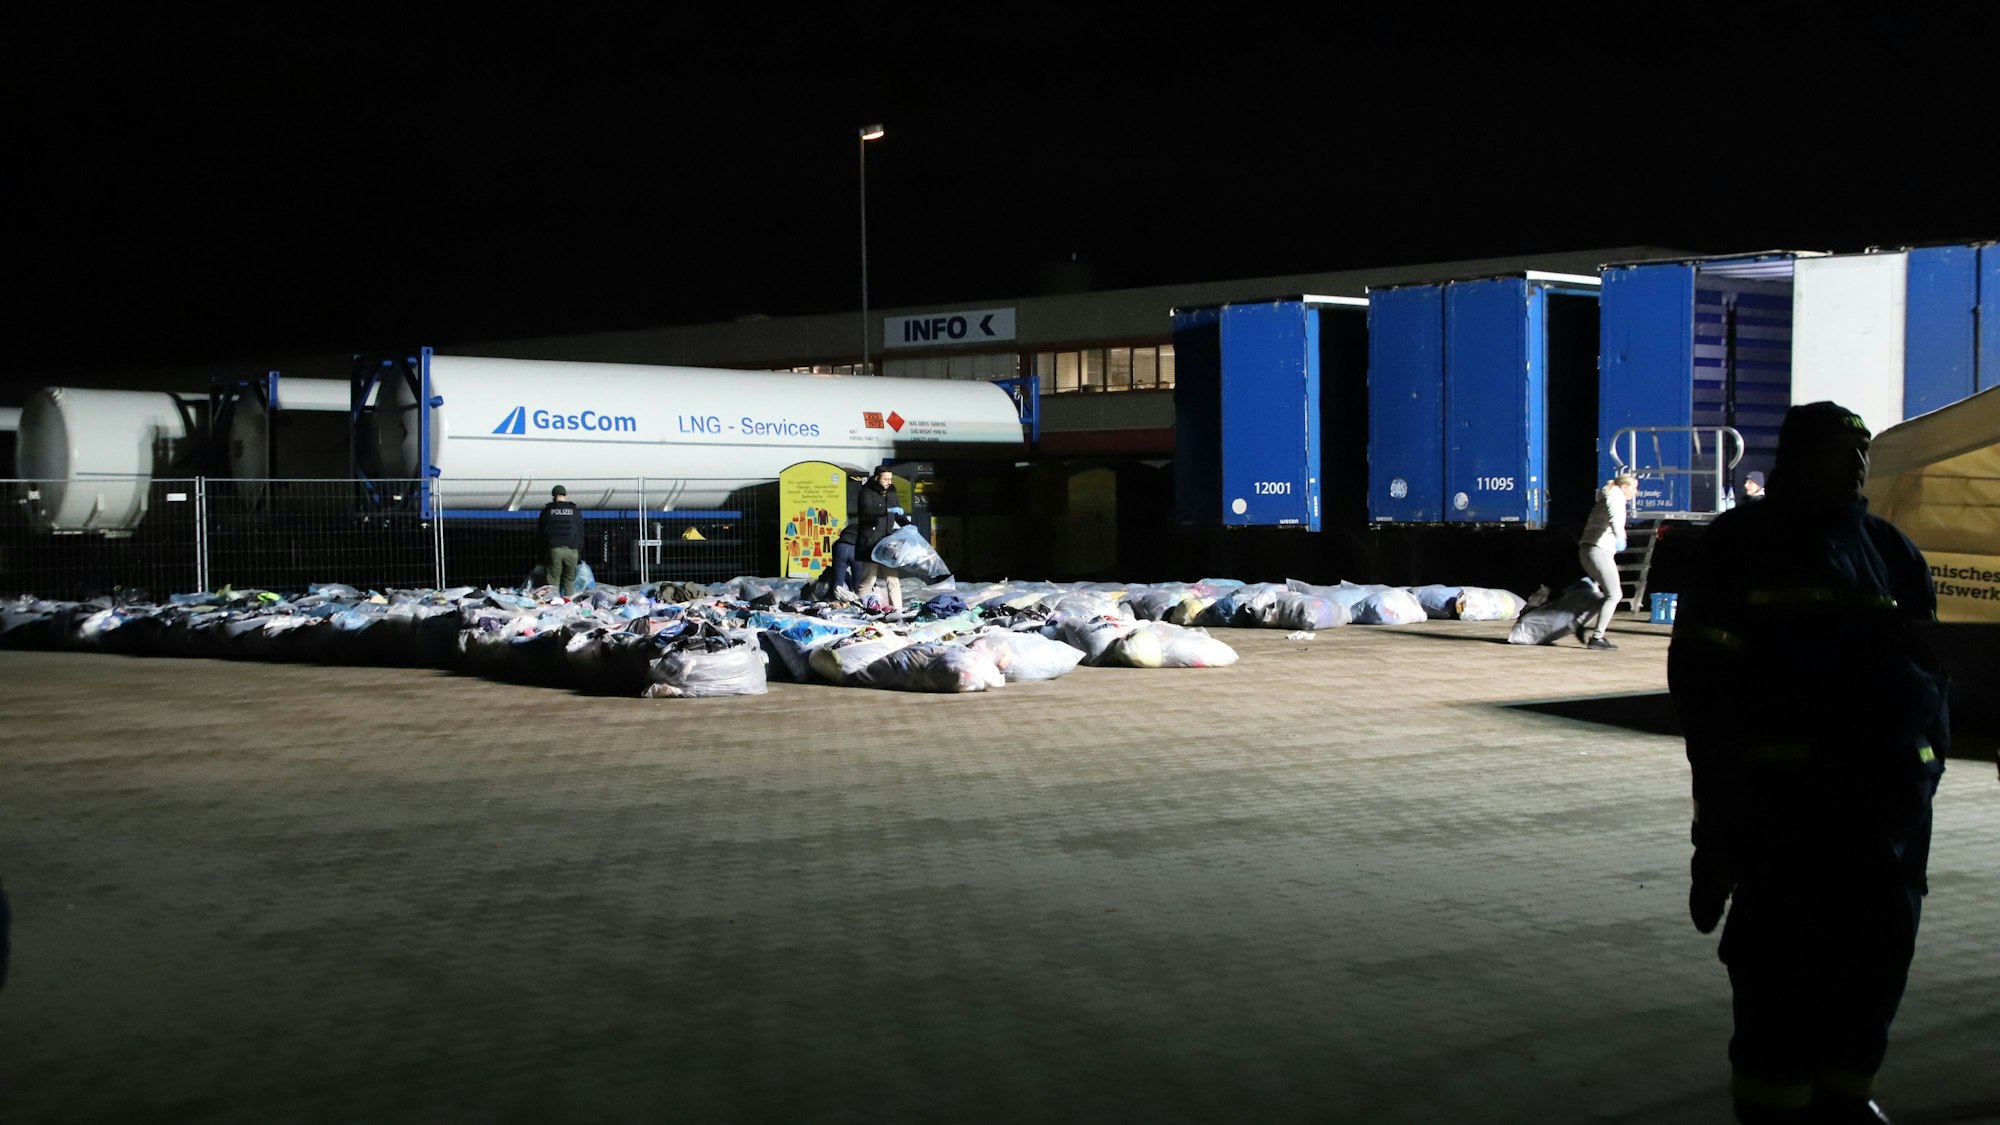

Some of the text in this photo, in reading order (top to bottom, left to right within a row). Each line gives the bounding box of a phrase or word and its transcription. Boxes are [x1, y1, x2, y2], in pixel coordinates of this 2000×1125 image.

[904, 316, 967, 342] INFO
[533, 409, 637, 432] GasCom
[678, 415, 721, 434] LNG
[741, 417, 820, 437] Services
[1254, 481, 1291, 494] 12001
[1477, 477, 1515, 491] 11095
[550, 508, 574, 516] POLIZEI
